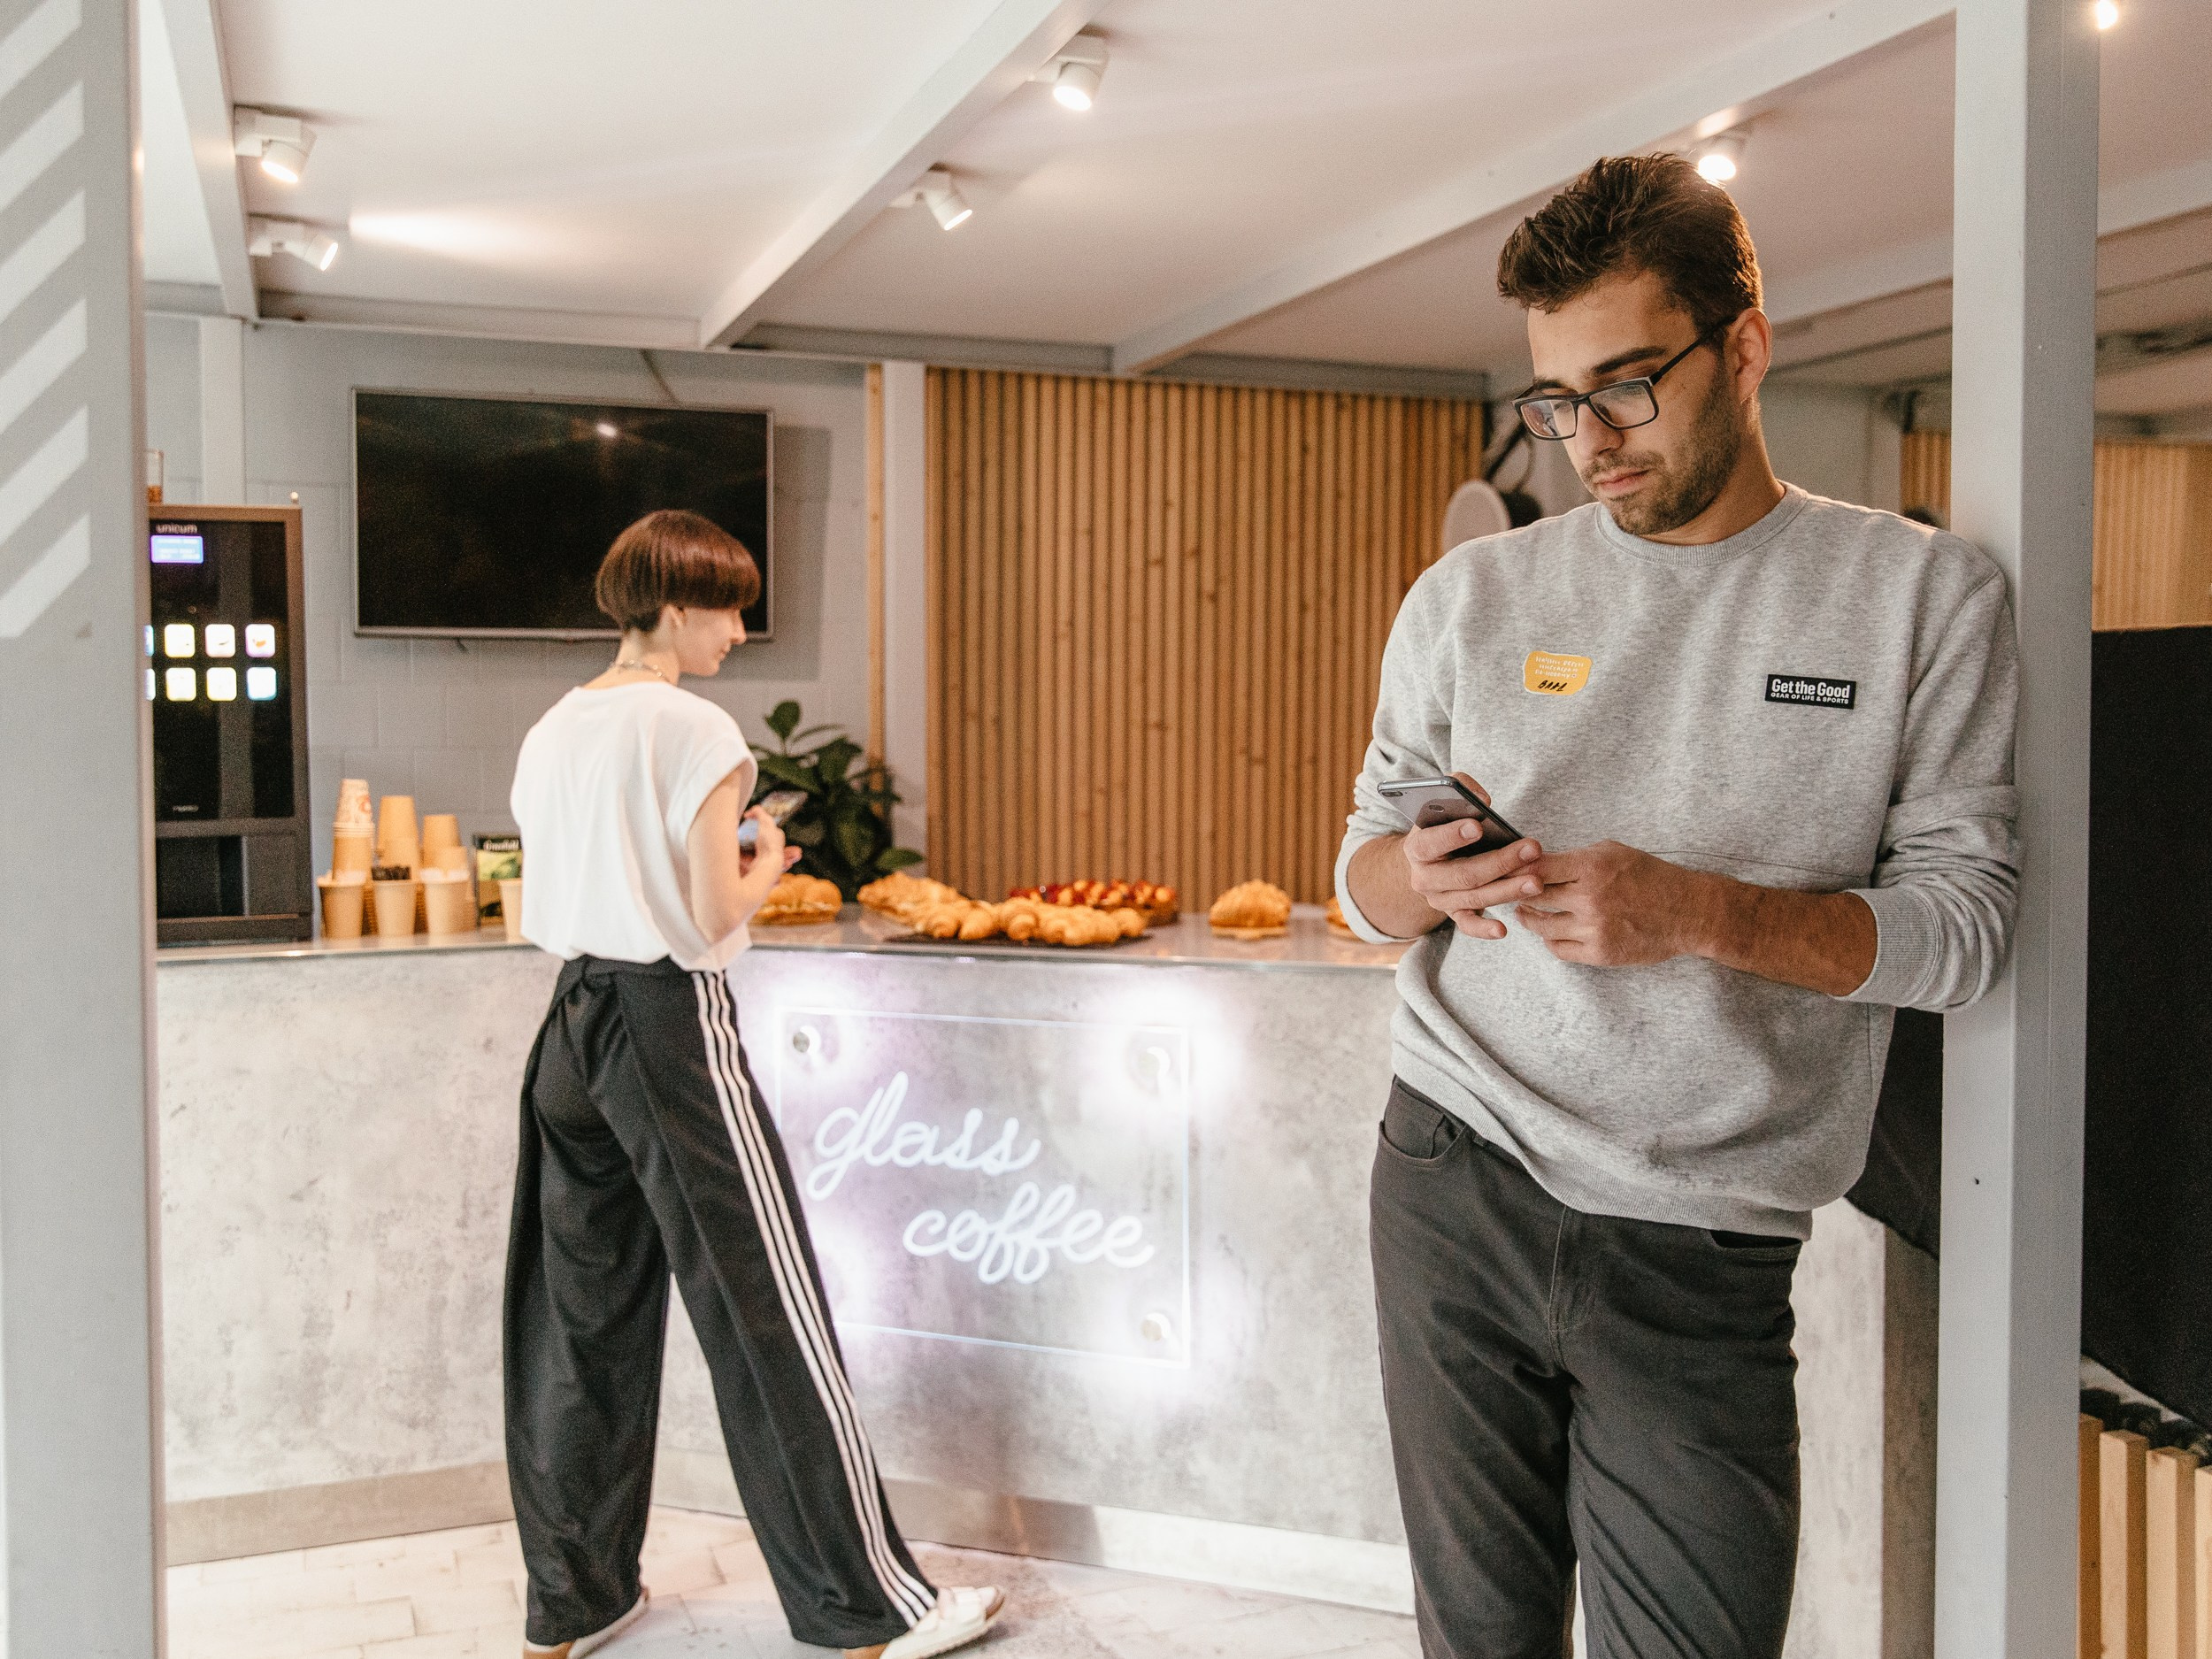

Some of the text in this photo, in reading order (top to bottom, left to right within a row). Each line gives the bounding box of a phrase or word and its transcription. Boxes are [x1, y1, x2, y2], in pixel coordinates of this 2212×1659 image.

[156, 523, 197, 534] unicum
[1771, 679, 1851, 699] Get the Good
[806, 1070, 1041, 1202] glass
[902, 1180, 1156, 1285] coffee
